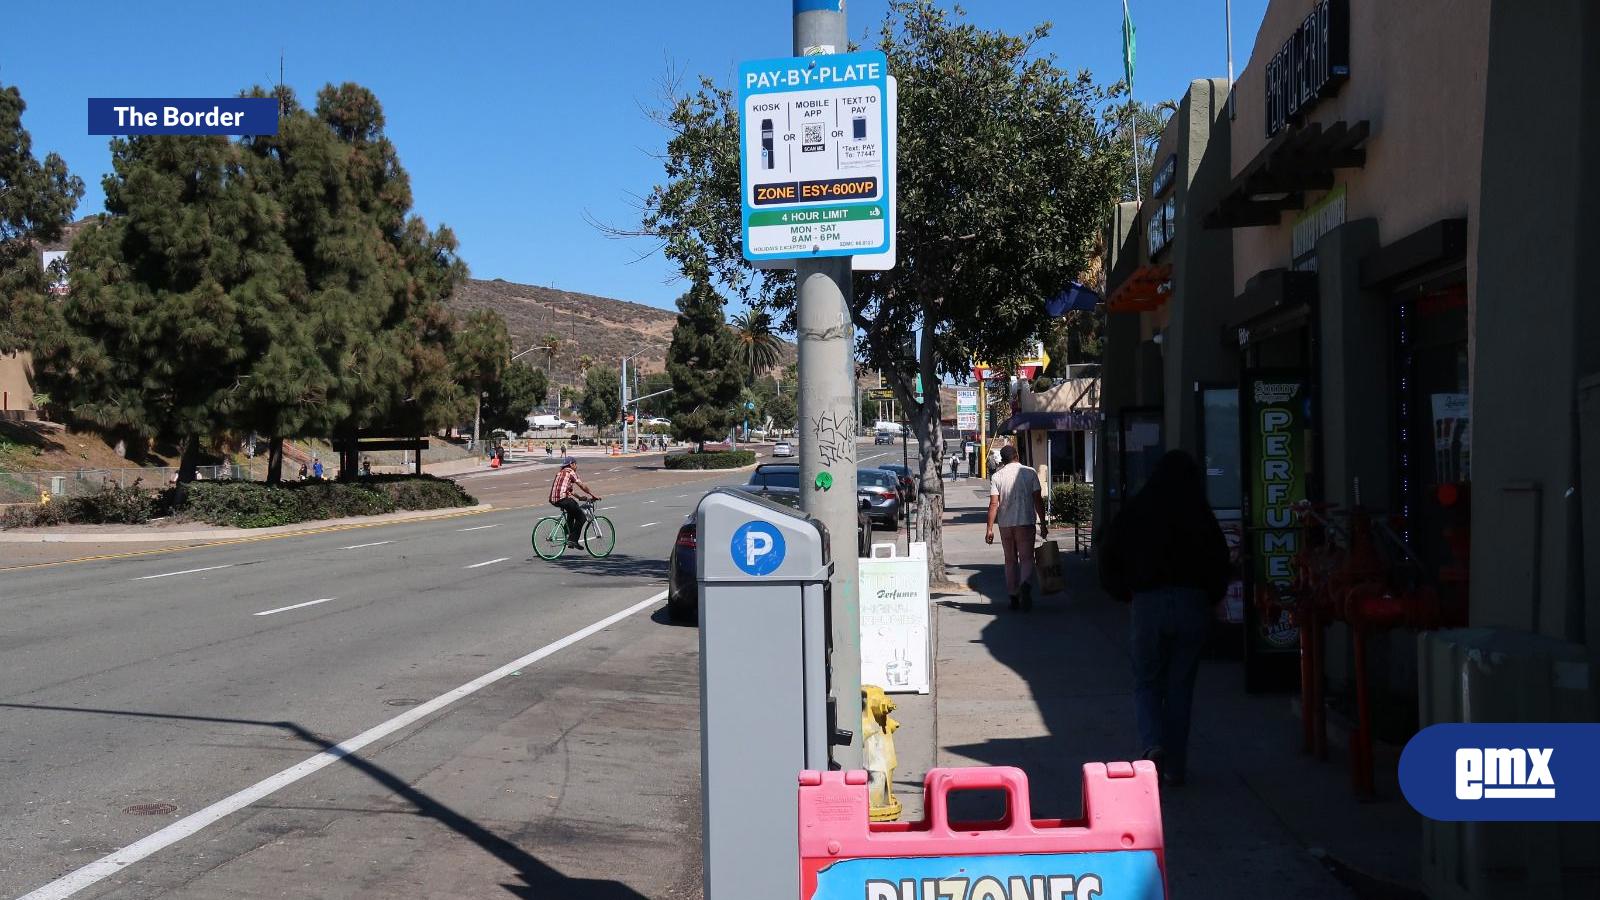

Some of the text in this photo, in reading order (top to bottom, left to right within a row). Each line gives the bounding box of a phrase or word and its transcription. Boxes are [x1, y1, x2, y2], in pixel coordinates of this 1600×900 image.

[746, 63, 880, 89] PAY-BY-PLATE
[795, 99, 830, 109] MOBILE
[842, 95, 876, 106] TEXT TO
[752, 103, 781, 112] KIOSK
[851, 106, 867, 115] PAY
[804, 109, 822, 118] APP
[783, 133, 796, 142] OR
[831, 130, 844, 138] OR
[862, 143, 875, 151] PAY
[857, 150, 876, 158] 77447
[757, 181, 874, 200] ZONE ESY-600VP
[781, 209, 849, 222] 4 HOUR LIMIT
[790, 226, 812, 235] MON
[820, 224, 837, 233] SAT
[791, 234, 812, 243] 8AM
[820, 233, 841, 242] 6PM
[746, 531, 774, 566] P
[876, 589, 918, 600] Perfumes
